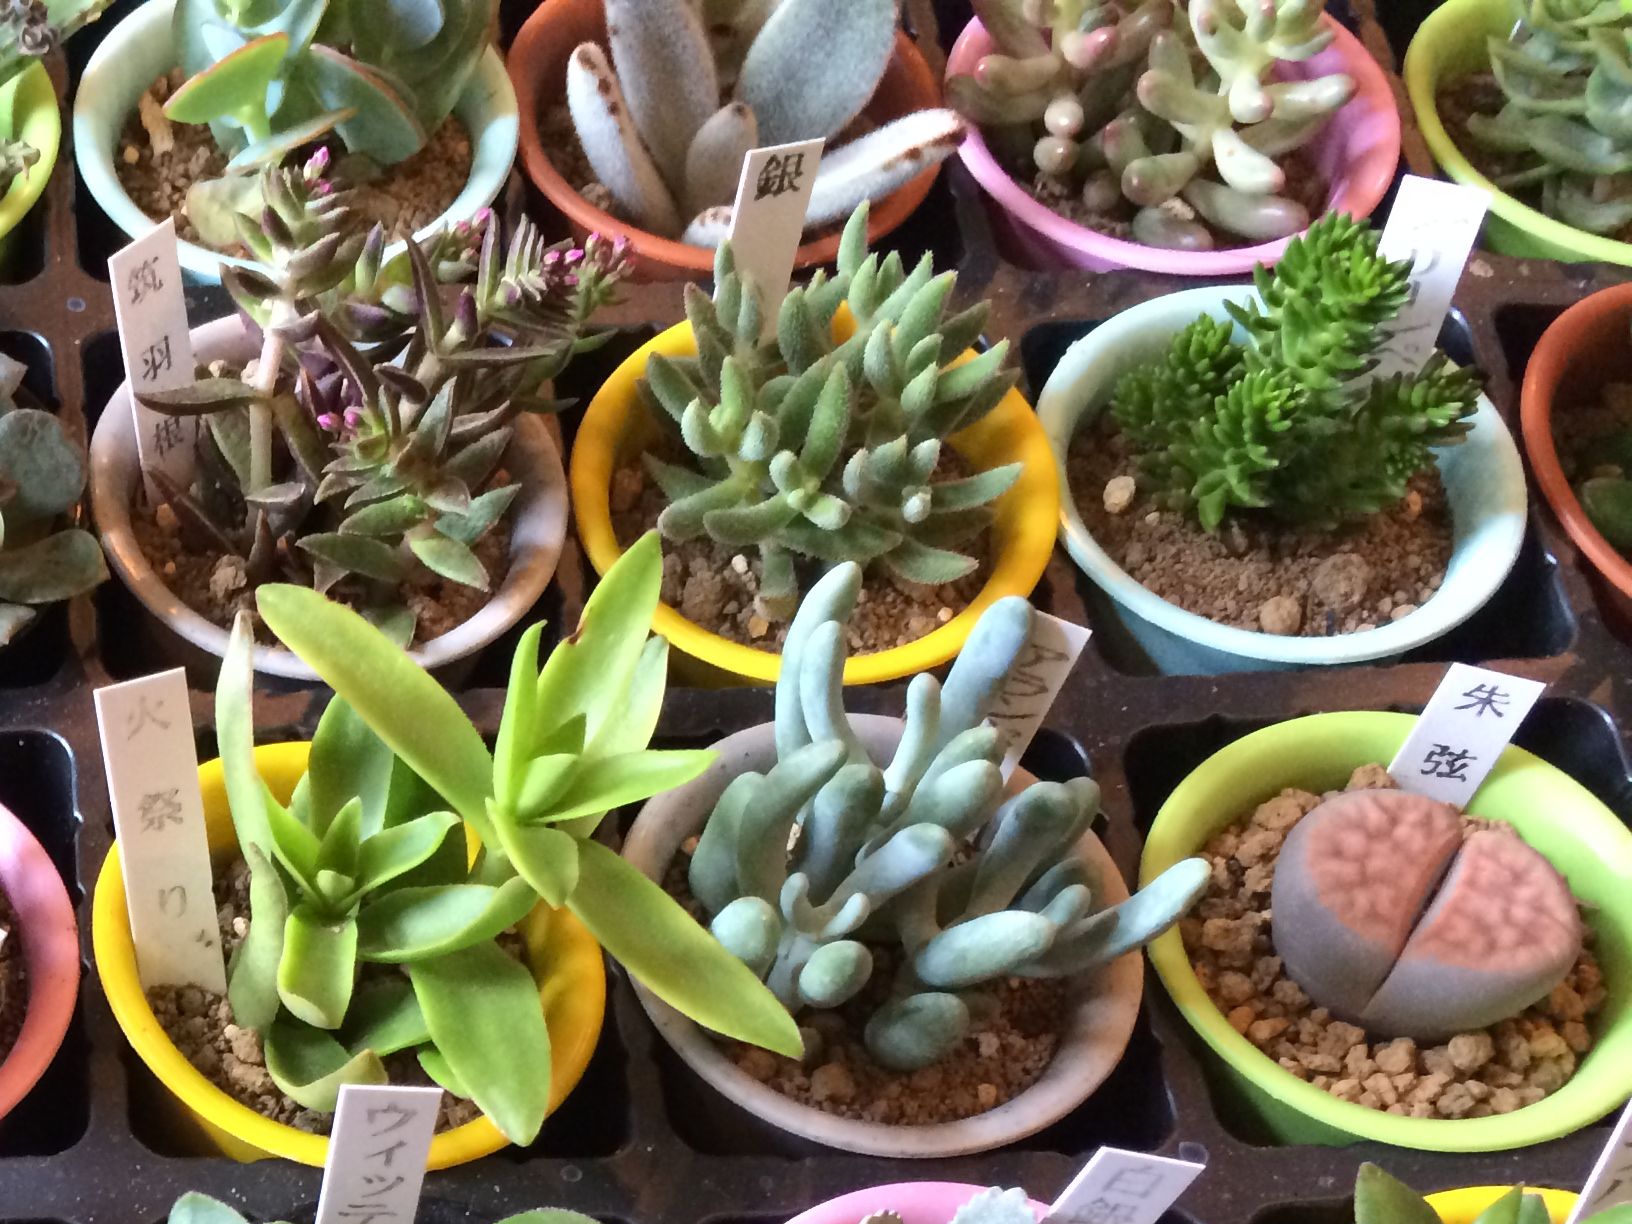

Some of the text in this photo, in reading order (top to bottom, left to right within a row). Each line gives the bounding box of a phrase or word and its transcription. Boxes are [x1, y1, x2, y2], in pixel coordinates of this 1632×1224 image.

[753, 152, 805, 202] 銀
[125, 696, 188, 920] 火祭り
